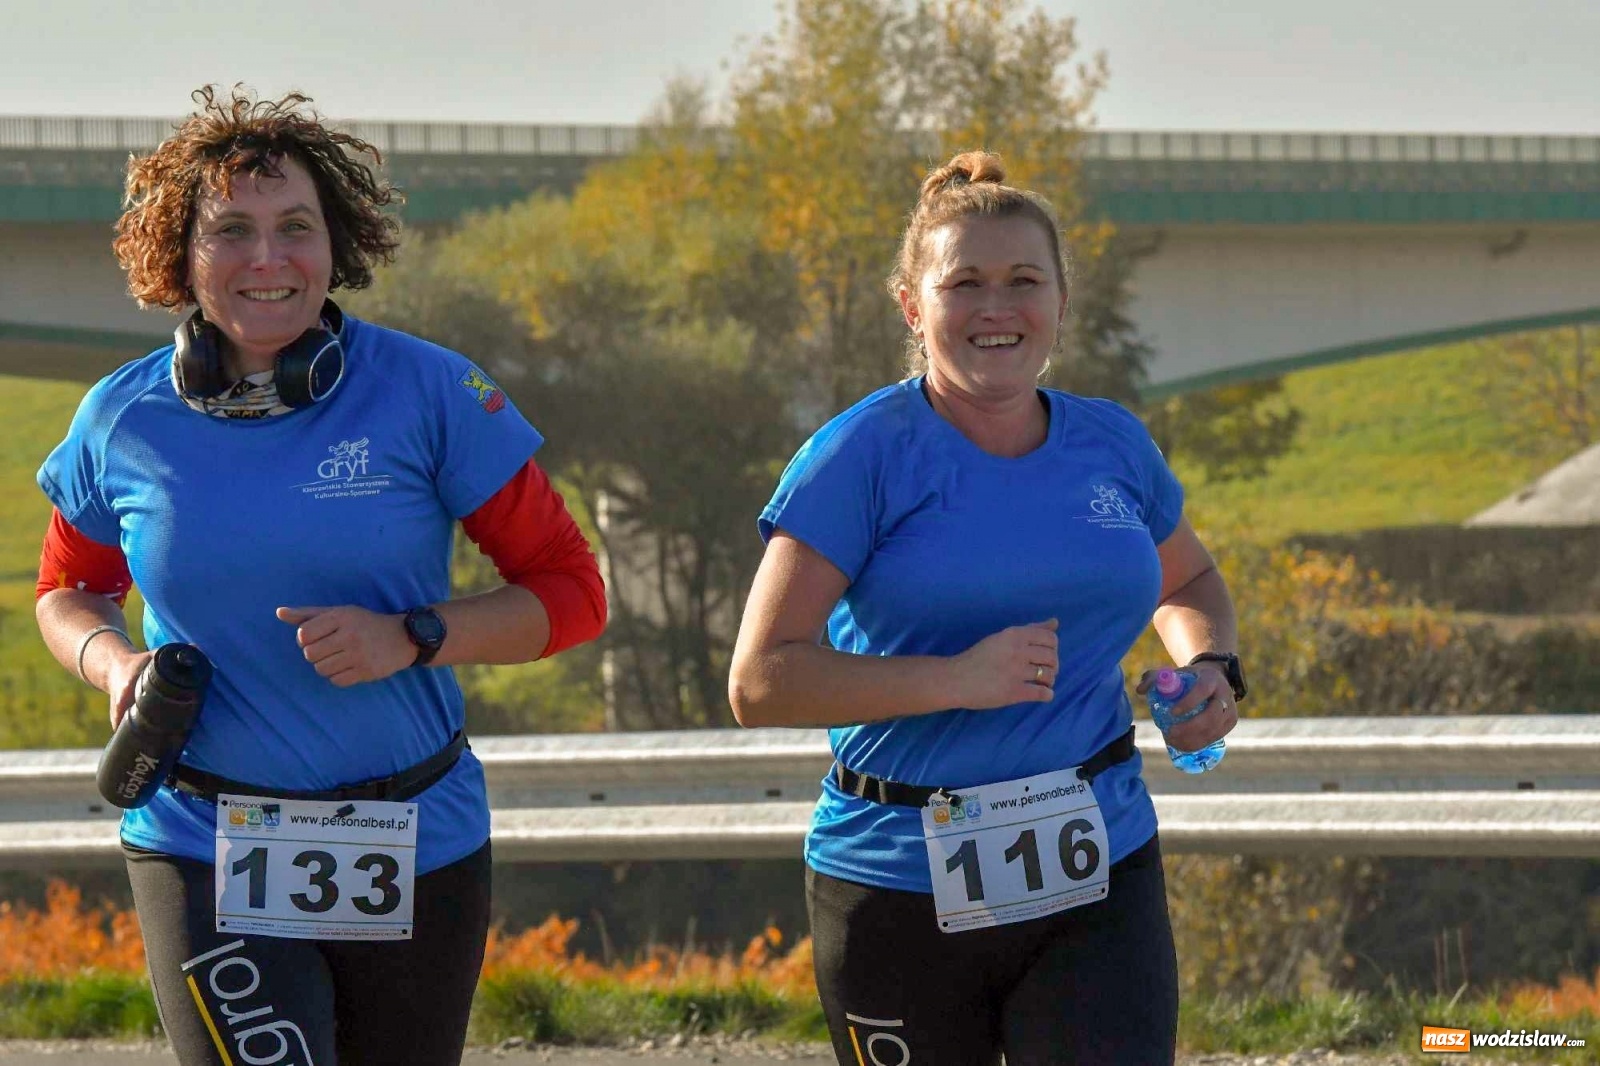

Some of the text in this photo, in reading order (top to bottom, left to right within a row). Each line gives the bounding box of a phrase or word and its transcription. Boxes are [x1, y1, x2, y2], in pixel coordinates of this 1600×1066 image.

[317, 449, 370, 482] Gryf
[990, 782, 1086, 812] www.personalbest.pl
[290, 813, 409, 831] www.personalbest.pl
[945, 818, 1099, 902] 116
[232, 847, 401, 915] 133
